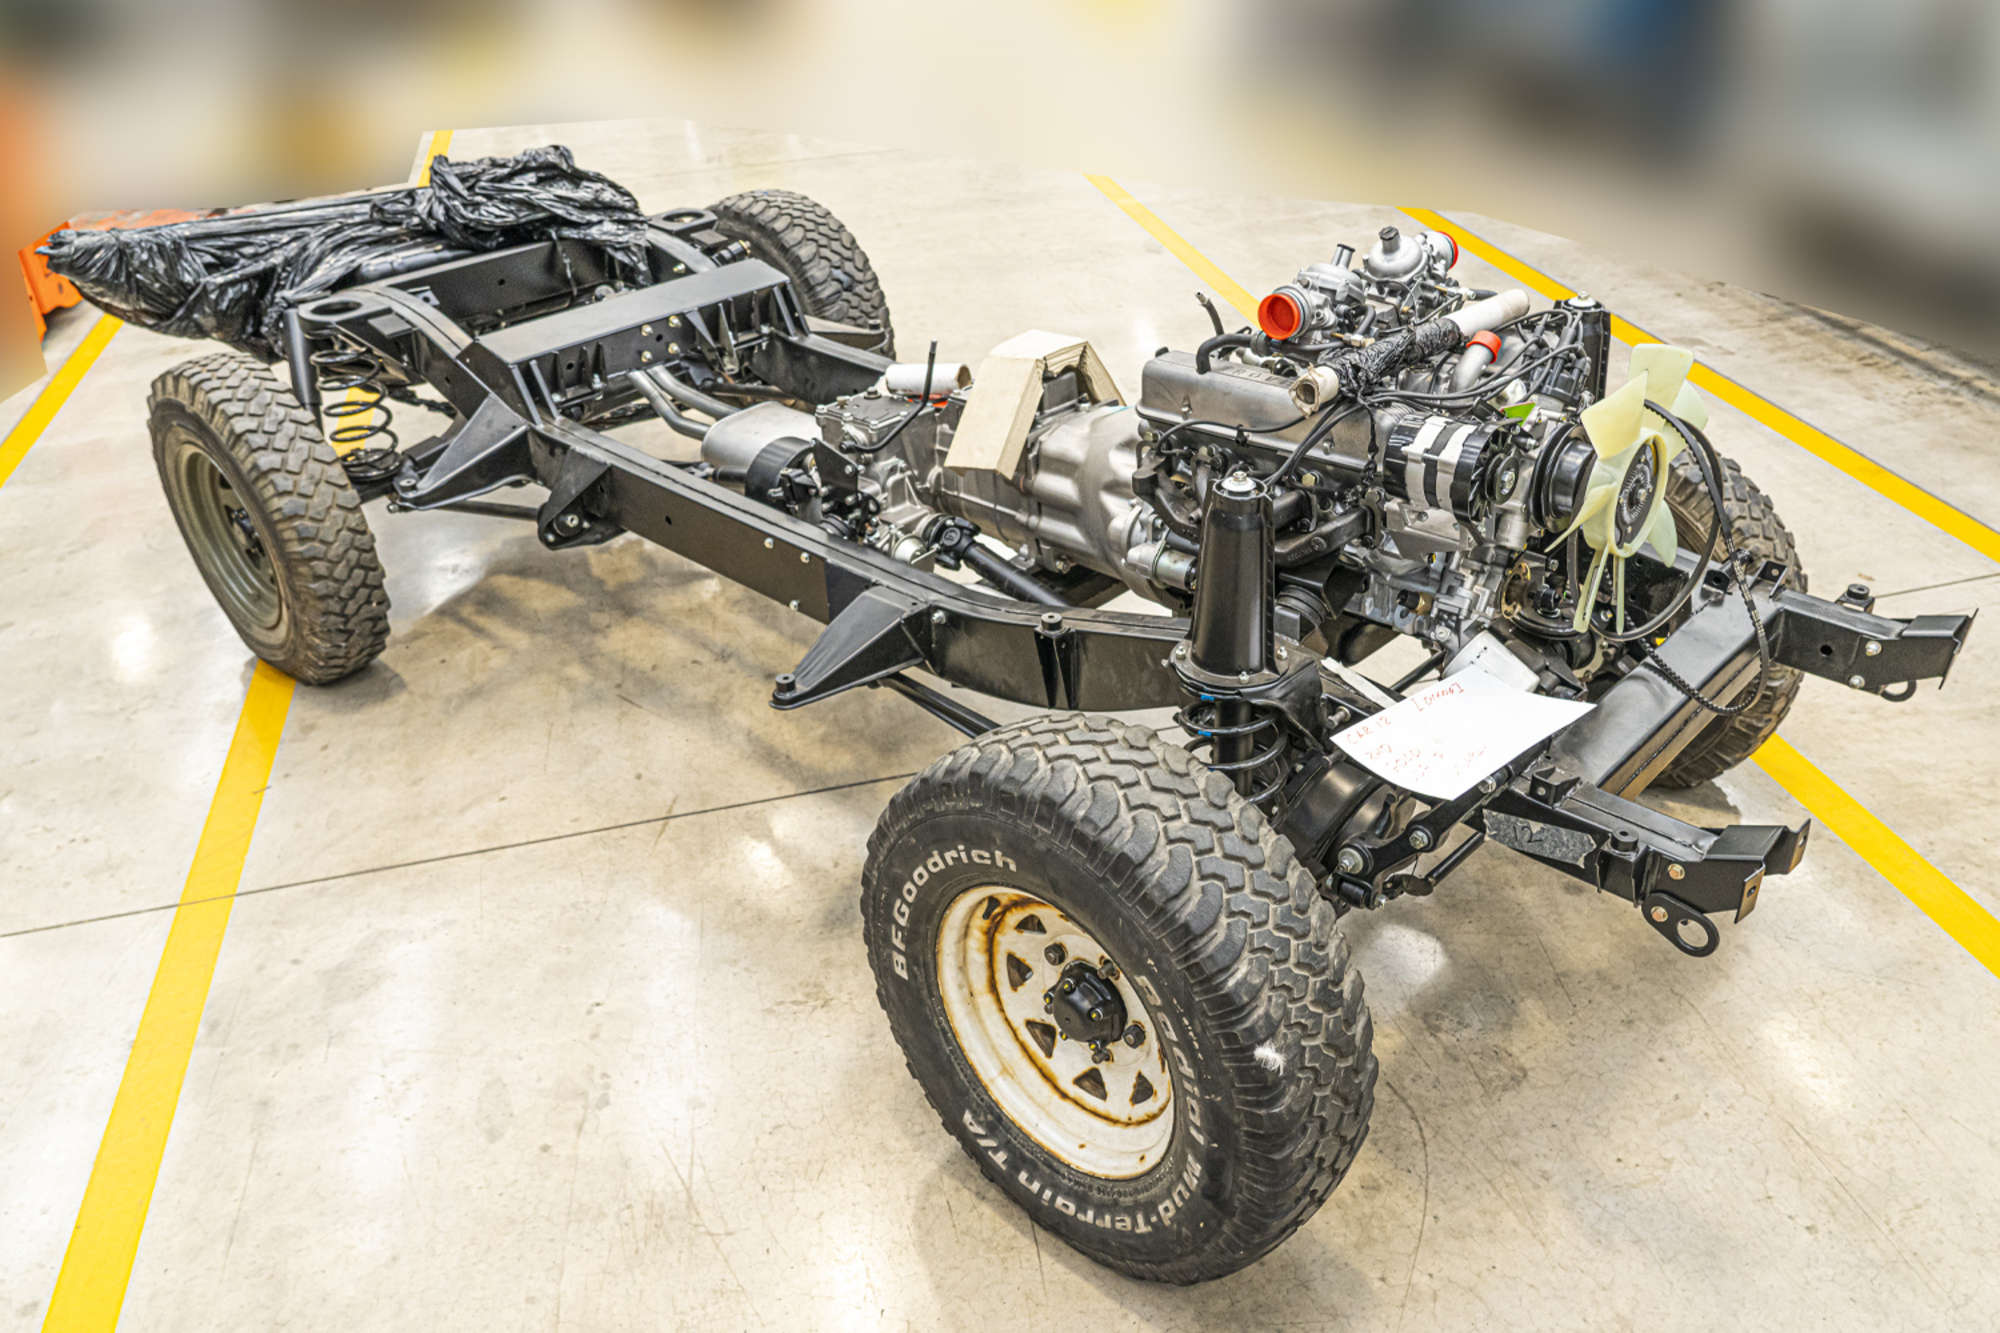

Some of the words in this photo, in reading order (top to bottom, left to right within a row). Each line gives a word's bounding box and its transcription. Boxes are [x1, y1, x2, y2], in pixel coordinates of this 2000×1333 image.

[1512, 825, 1544, 843] 12
[892, 844, 1017, 980] BFGoodrich
[963, 1109, 1009, 1171] T/A
[1017, 1153, 1202, 1234] Mud-Terrain
